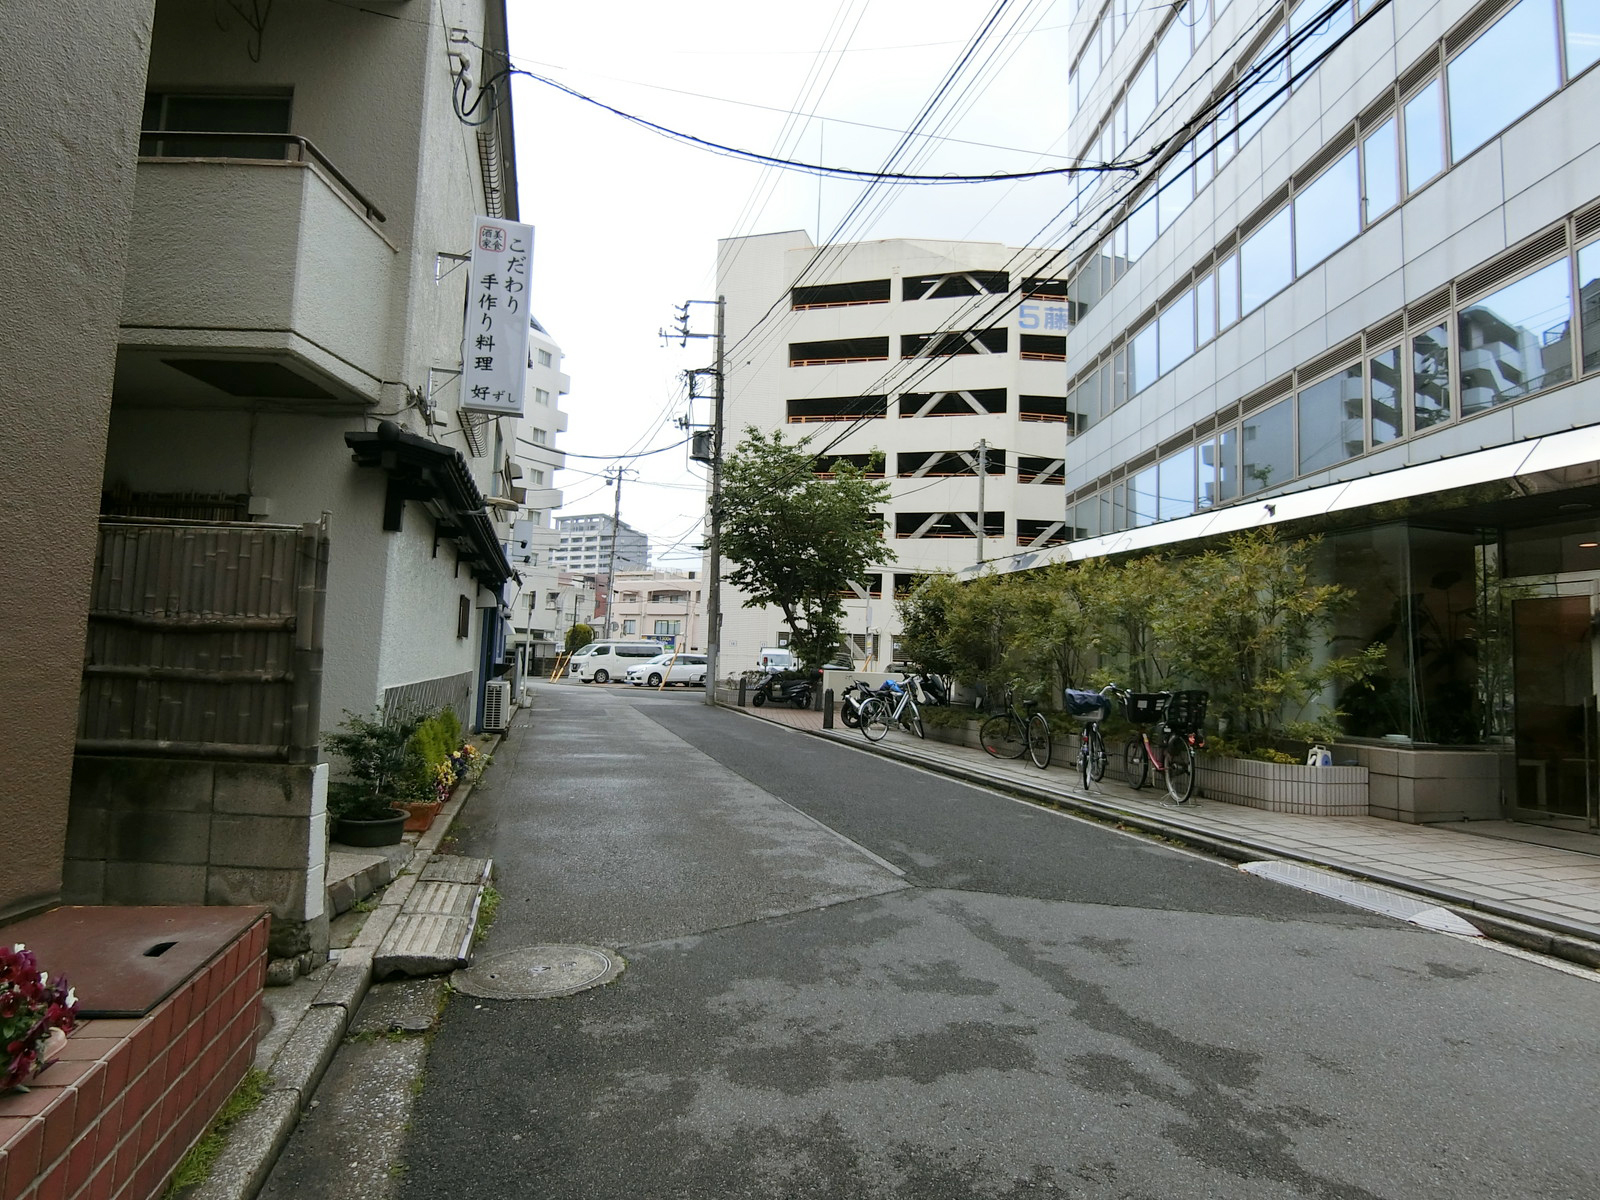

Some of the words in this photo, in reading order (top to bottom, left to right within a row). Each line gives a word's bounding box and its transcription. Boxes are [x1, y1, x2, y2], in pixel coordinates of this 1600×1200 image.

[505, 238, 526, 315] こだわり
[474, 273, 499, 372] 手作り料理
[471, 384, 516, 403] 好ずし
